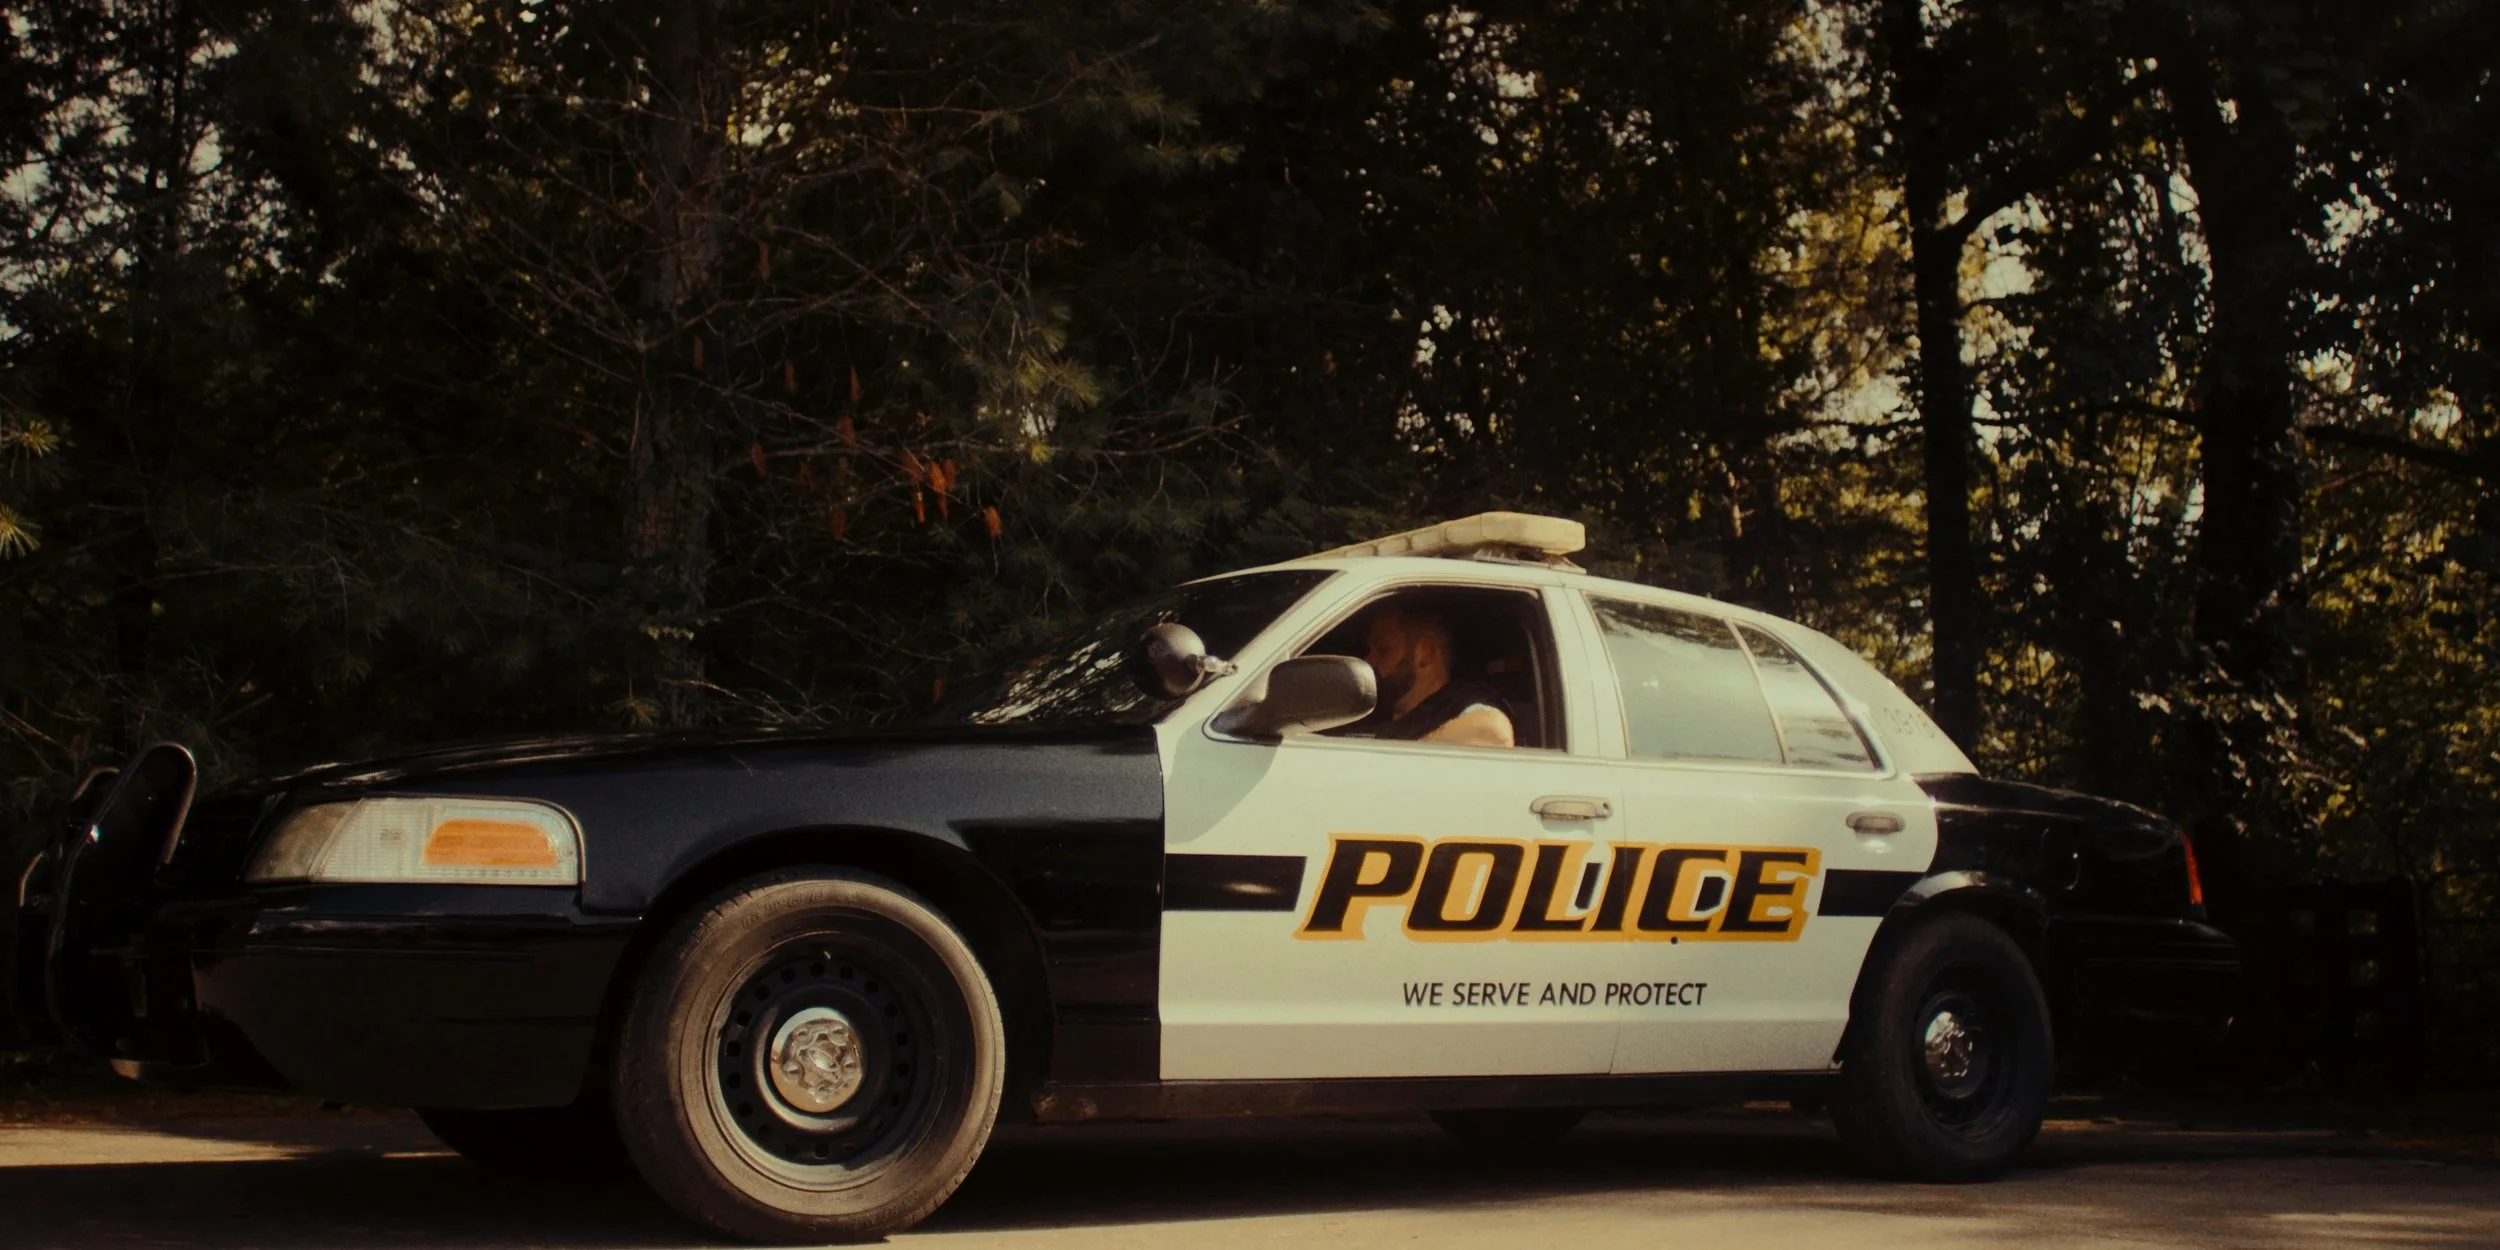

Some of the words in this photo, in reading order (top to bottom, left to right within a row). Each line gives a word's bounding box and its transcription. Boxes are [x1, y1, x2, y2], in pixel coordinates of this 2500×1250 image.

[1294, 833, 1821, 942] POLICE
[1402, 982, 1443, 1006] WE
[1452, 982, 1530, 1006] SERVE
[1539, 982, 1596, 1005] AND
[1605, 981, 1708, 1005] PROTECT
